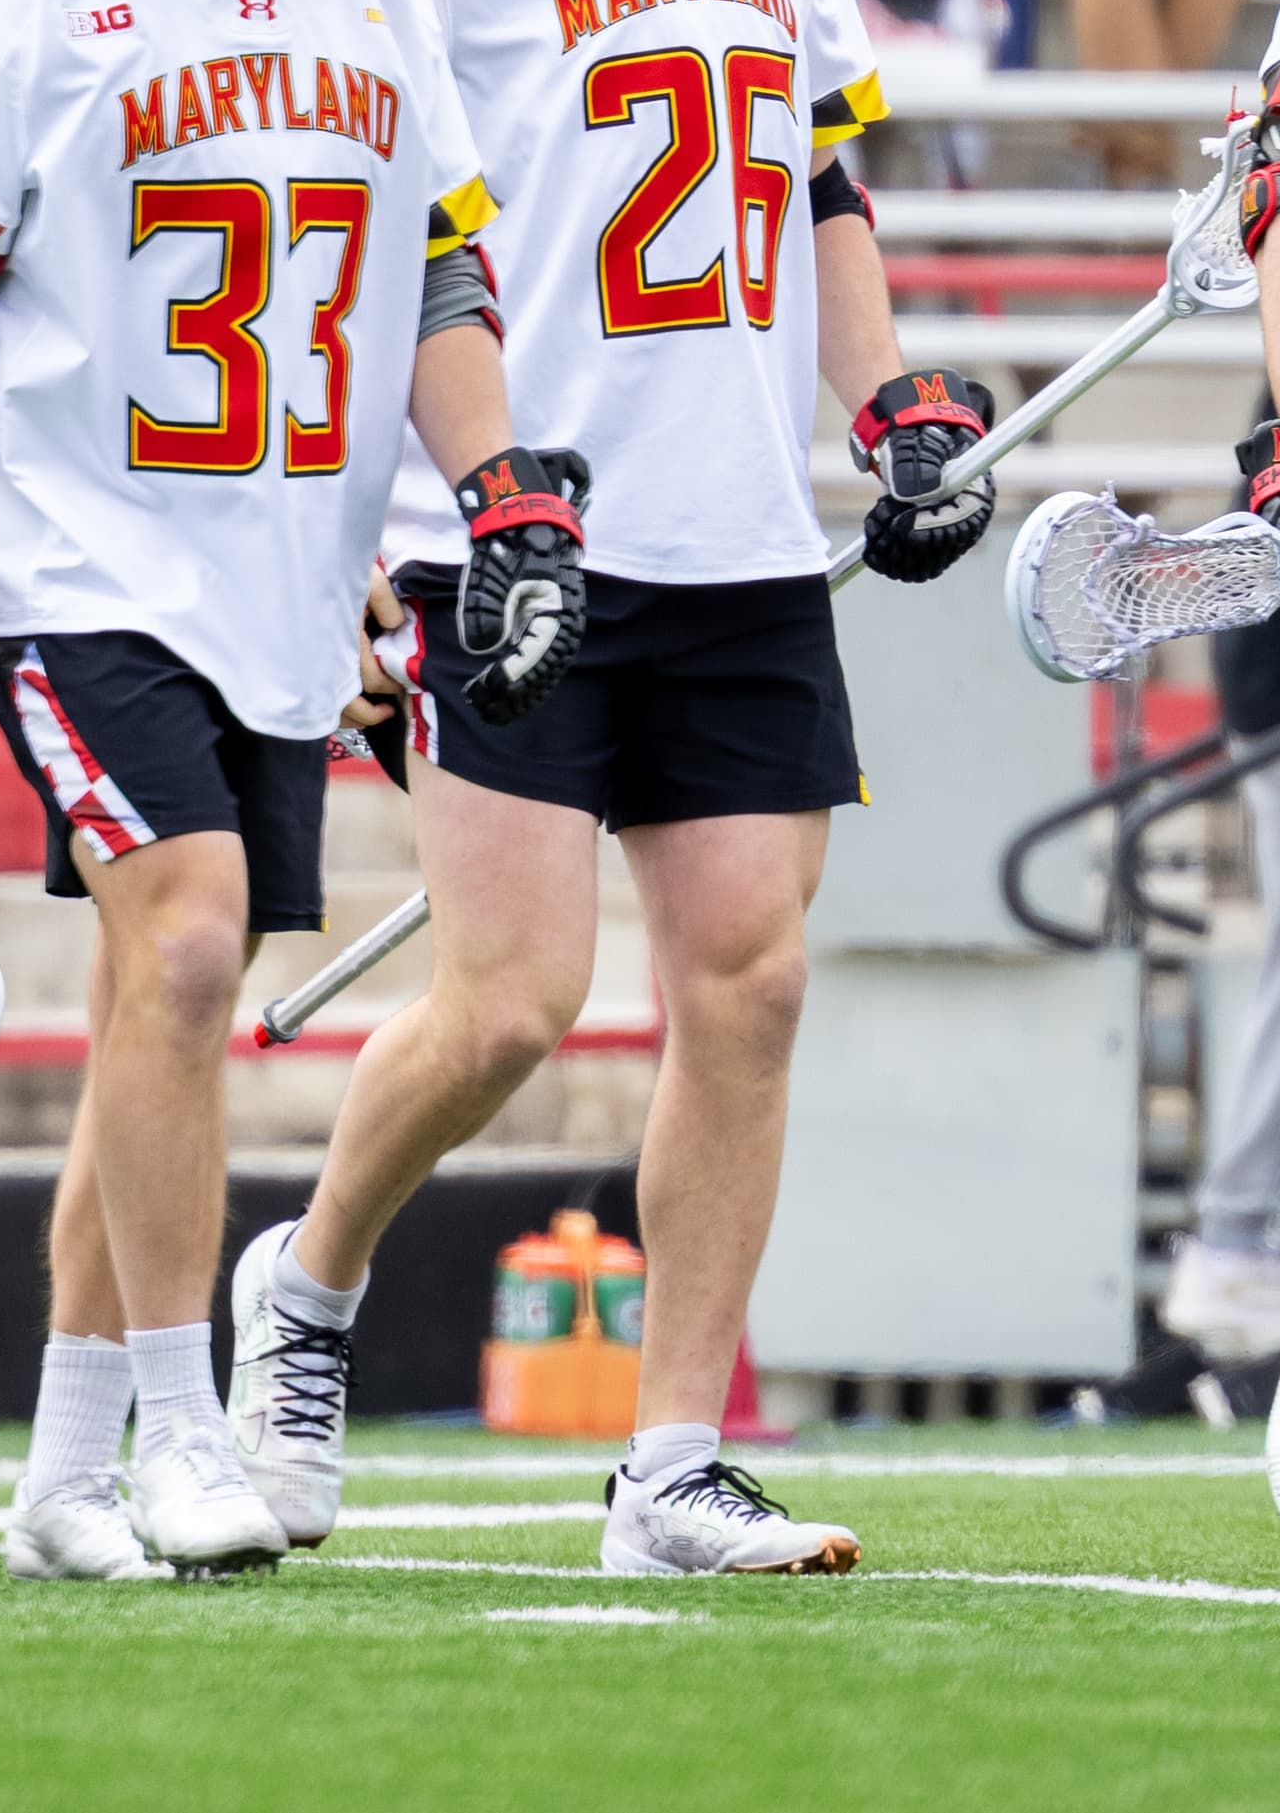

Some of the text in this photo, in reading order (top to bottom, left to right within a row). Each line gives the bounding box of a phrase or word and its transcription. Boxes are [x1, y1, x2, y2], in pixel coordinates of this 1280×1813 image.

[119, 52, 402, 171] MARYLAND
[584, 46, 799, 340] 26
[127, 176, 372, 478] 33
[912, 373, 952, 404] M
[479, 459, 522, 508] M
